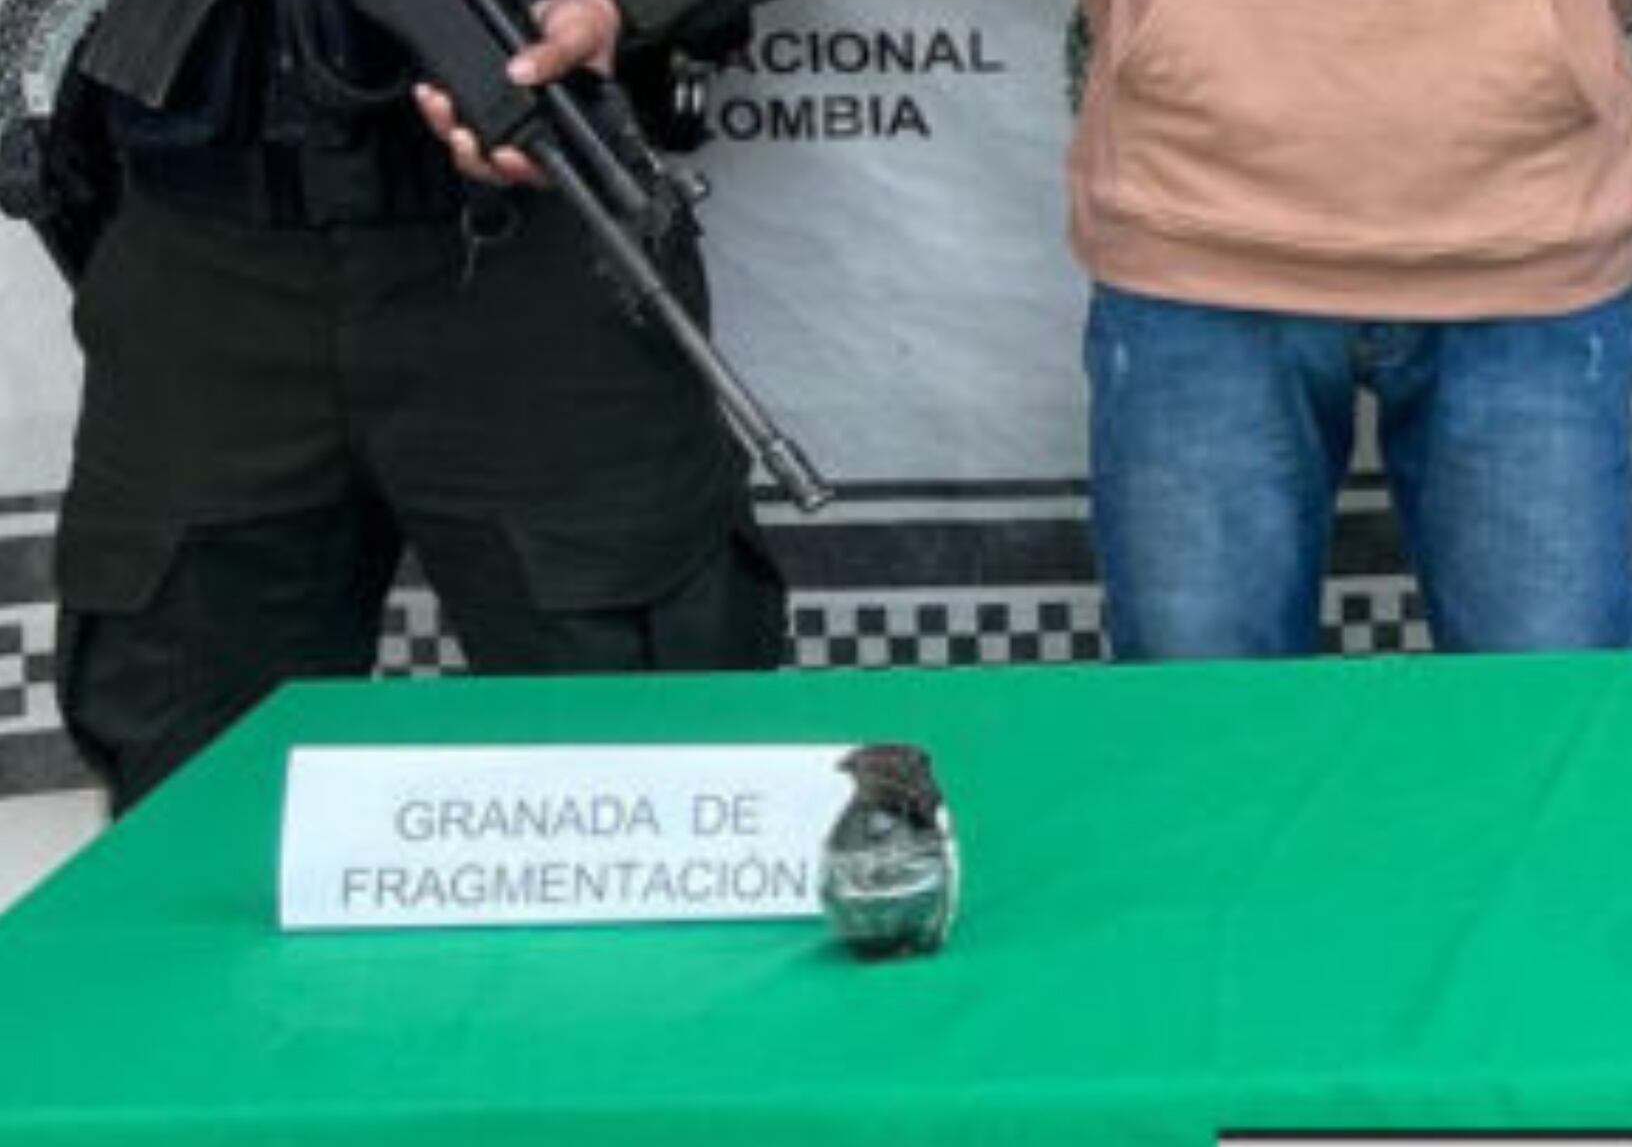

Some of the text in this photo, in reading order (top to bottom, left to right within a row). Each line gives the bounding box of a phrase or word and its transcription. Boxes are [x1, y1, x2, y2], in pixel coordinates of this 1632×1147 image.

[700, 95, 932, 142] OMBIA
[395, 795, 763, 842] GRANADA DE
[341, 853, 808, 908] FRAGMENTACIÓN
